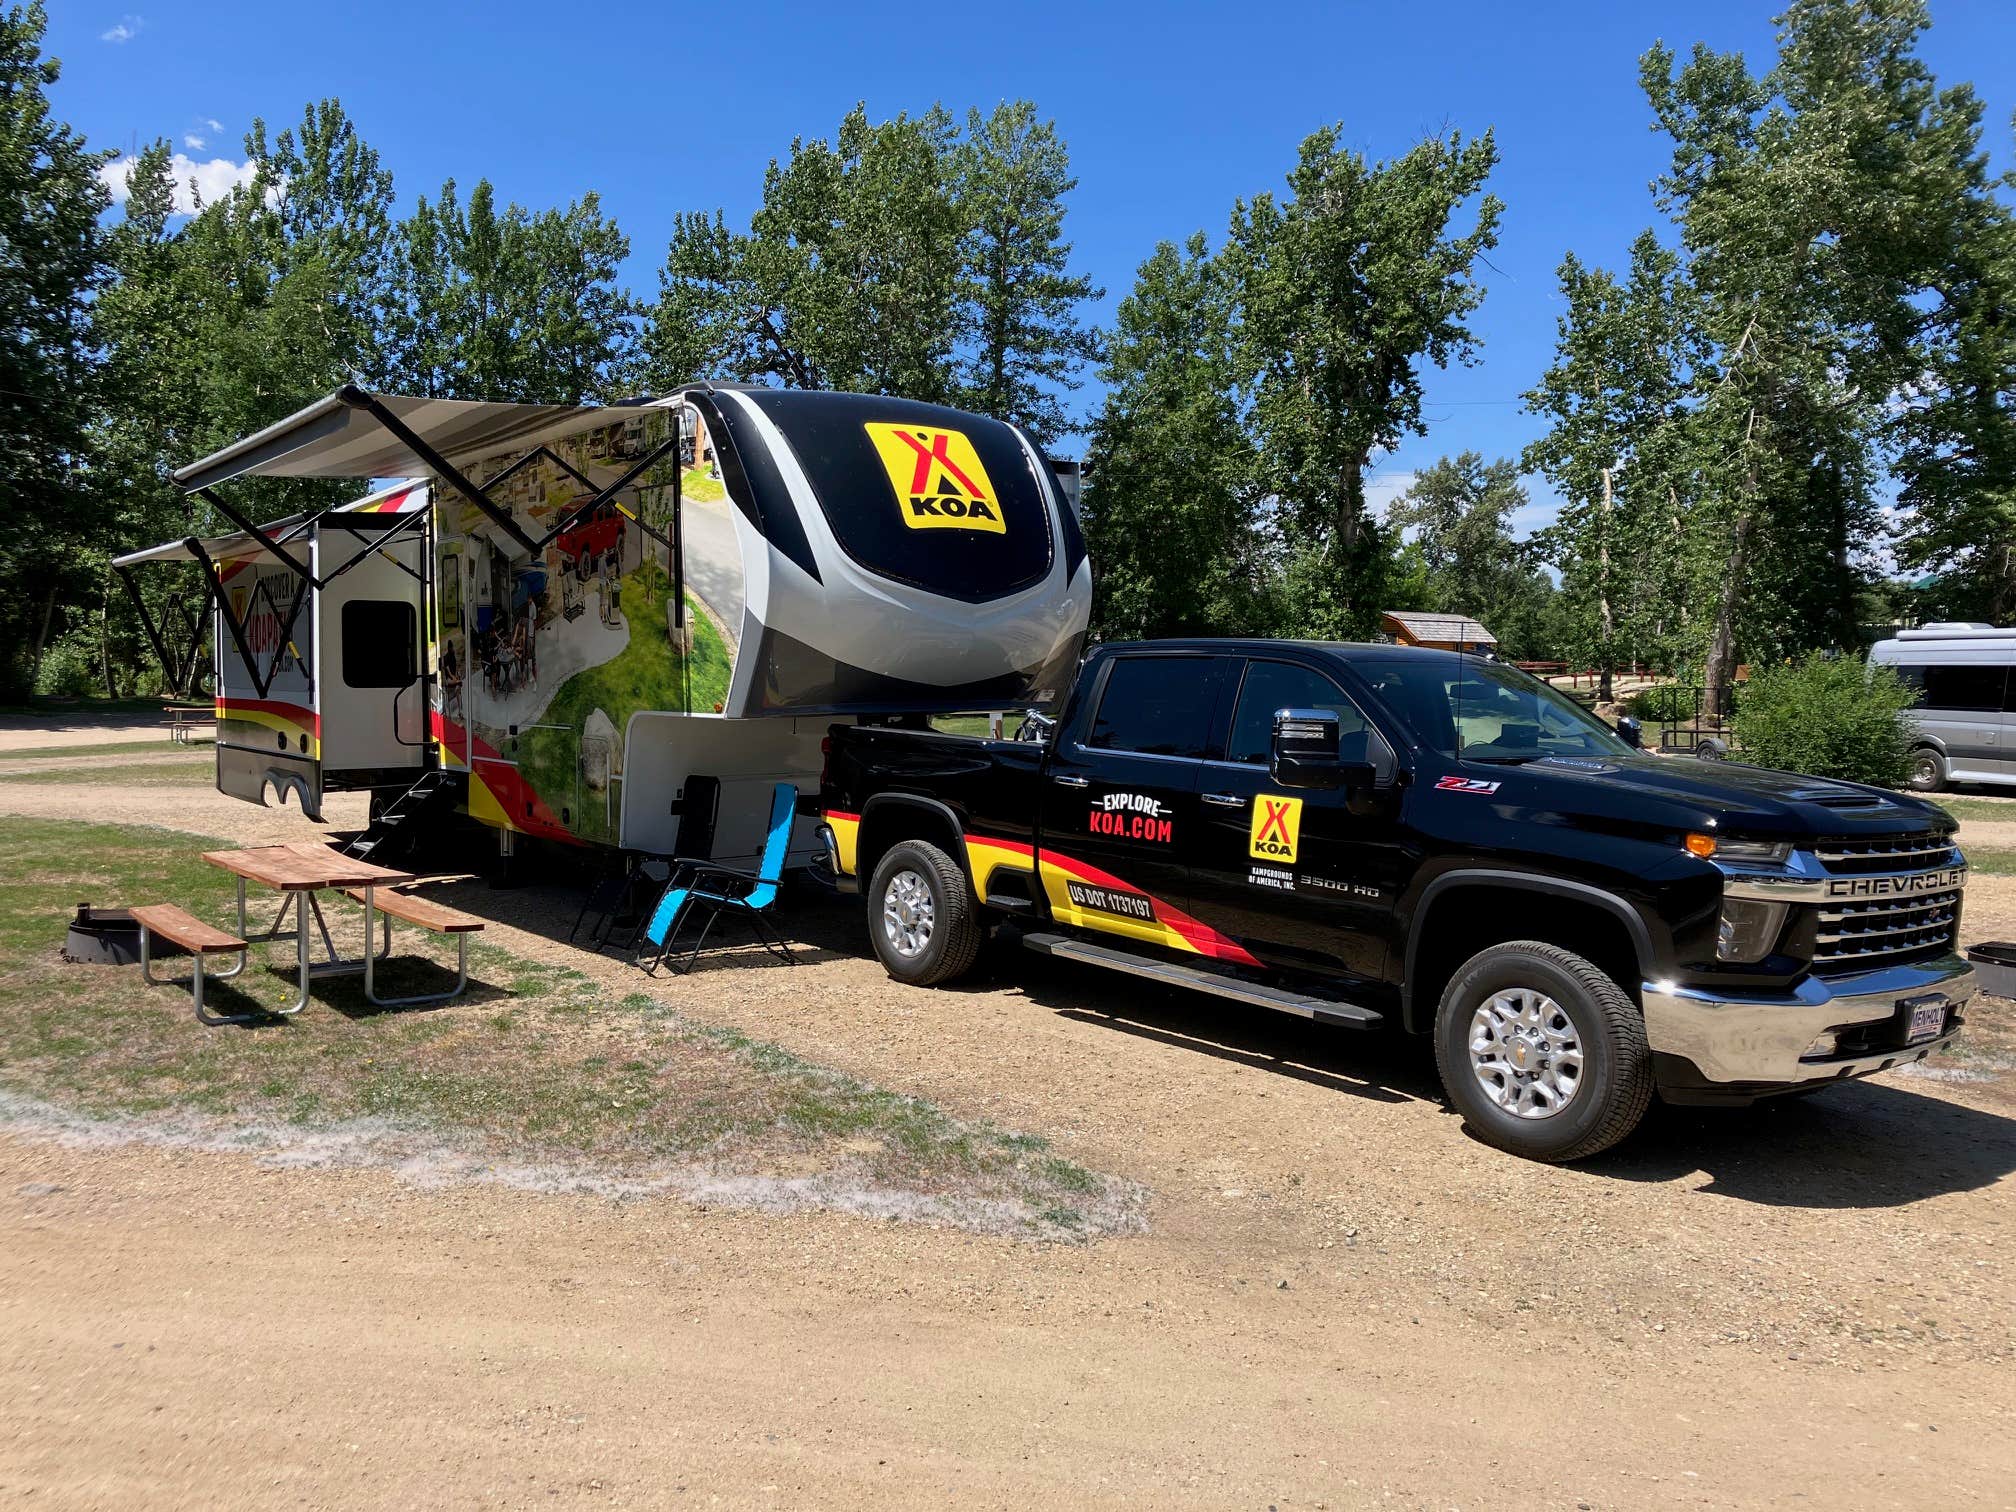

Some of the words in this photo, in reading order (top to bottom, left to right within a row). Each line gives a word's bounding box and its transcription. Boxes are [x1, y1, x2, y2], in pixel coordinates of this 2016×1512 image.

[909, 497, 998, 521] KOA
[1434, 776, 1502, 794] Z71
[1103, 793, 1162, 817] EXPLORE
[1090, 811, 1172, 842] KOA.COM
[1254, 841, 1293, 857] KOA
[1248, 874, 1256, 884] OF
[1256, 876, 1282, 890] AMERICA,
[1283, 881, 1296, 891] INC.
[1252, 866, 1293, 881] KAMPGROUNDS
[1830, 868, 1968, 896] CHEVROLET
[1301, 875, 1348, 892] 3500
[1354, 884, 1380, 898] HD
[1069, 885, 1086, 903] US
[1085, 888, 1107, 908] DOT
[1108, 893, 1151, 918] 1737197
